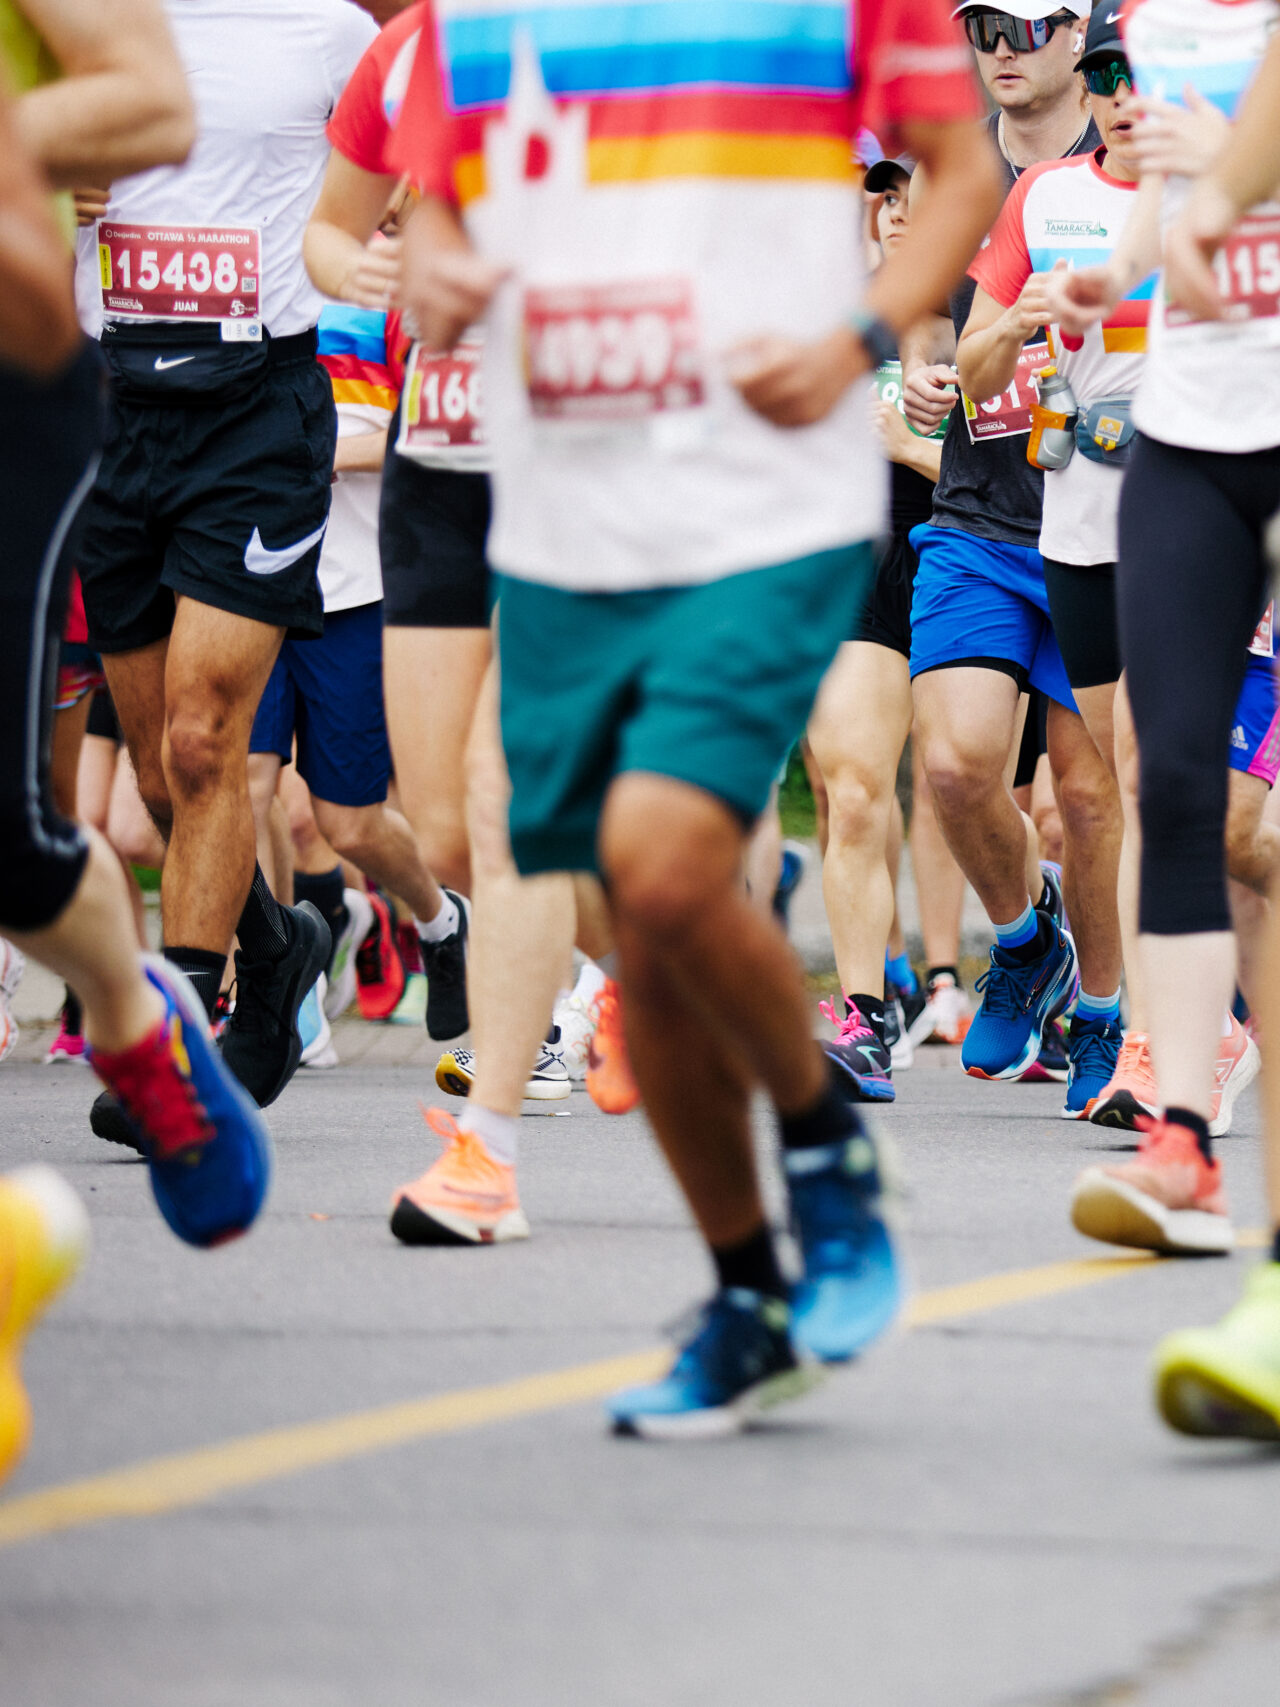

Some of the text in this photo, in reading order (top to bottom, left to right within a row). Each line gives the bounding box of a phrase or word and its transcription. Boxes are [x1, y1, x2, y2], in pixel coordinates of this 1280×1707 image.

[147, 232, 184, 242] OTTAWA
[198, 234, 250, 244] MARATHON
[117, 249, 239, 294] 15438
[173, 301, 199, 312] JUAN
